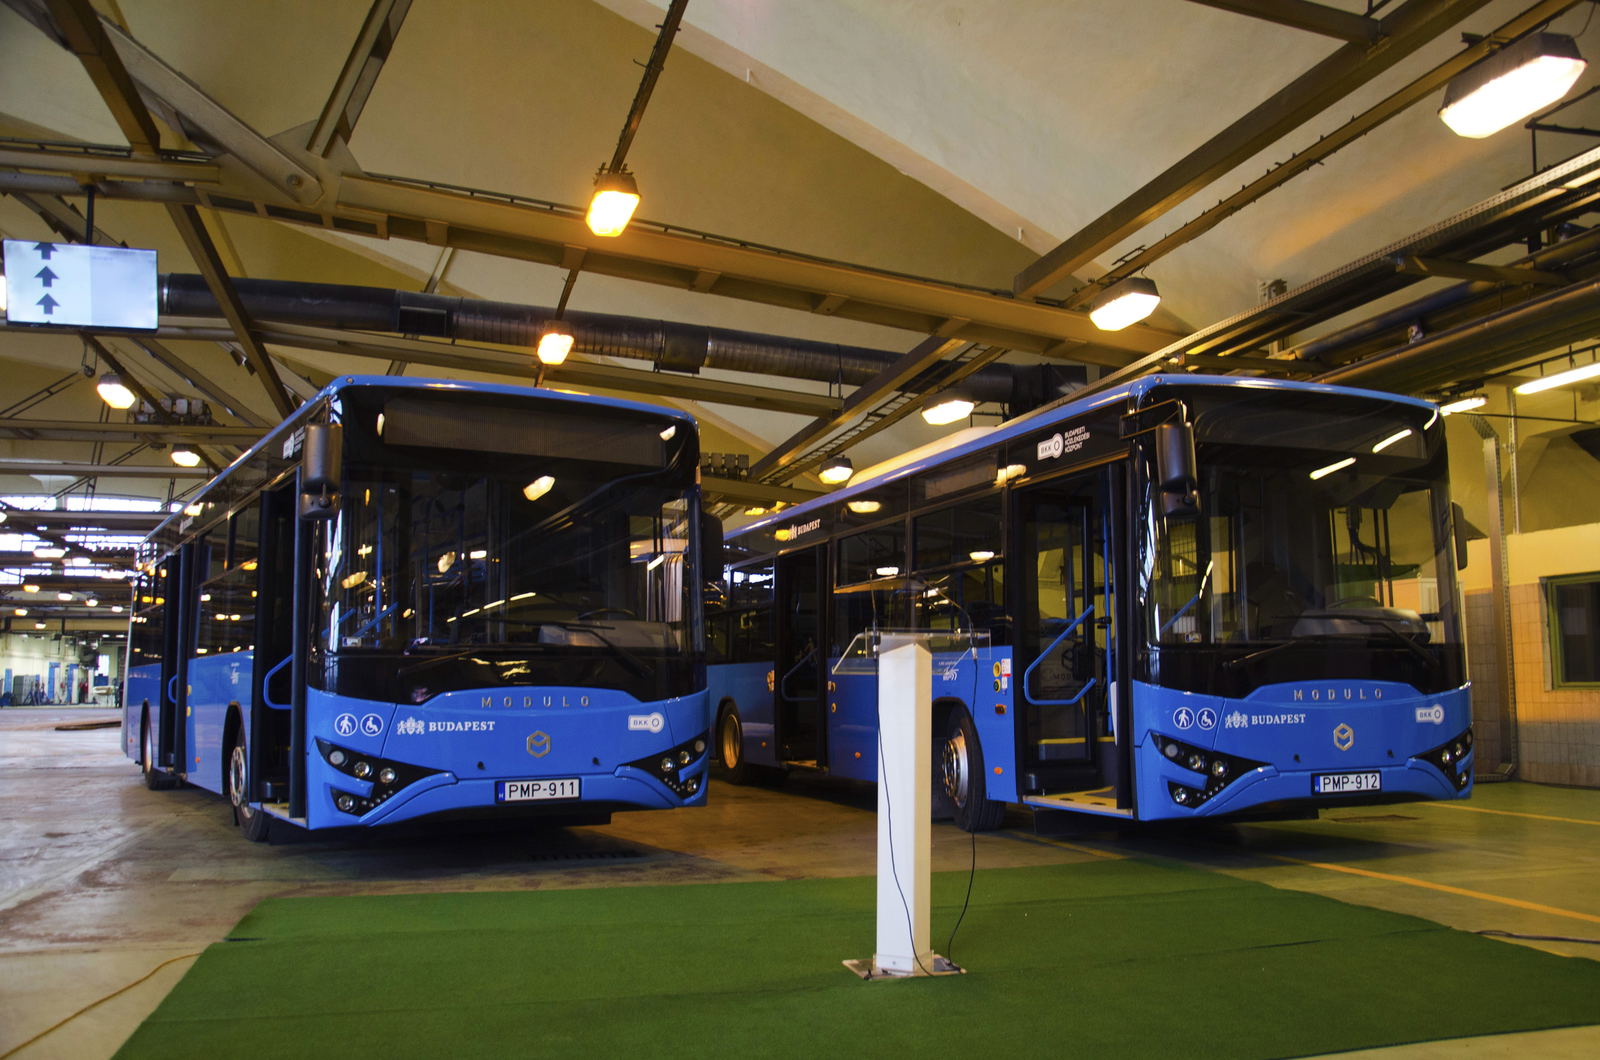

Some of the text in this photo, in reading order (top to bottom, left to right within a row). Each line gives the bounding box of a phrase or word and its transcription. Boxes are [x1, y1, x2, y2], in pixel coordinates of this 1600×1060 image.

[797, 518, 821, 536] BUDAPEST
[1293, 688, 1382, 701] MODULO
[481, 696, 590, 708] MODULO
[1251, 713, 1306, 725] BUDAPEST
[428, 721, 495, 733] BUDAPEST
[1322, 774, 1378, 791] PMP-912
[508, 782, 575, 799] PMP-911
